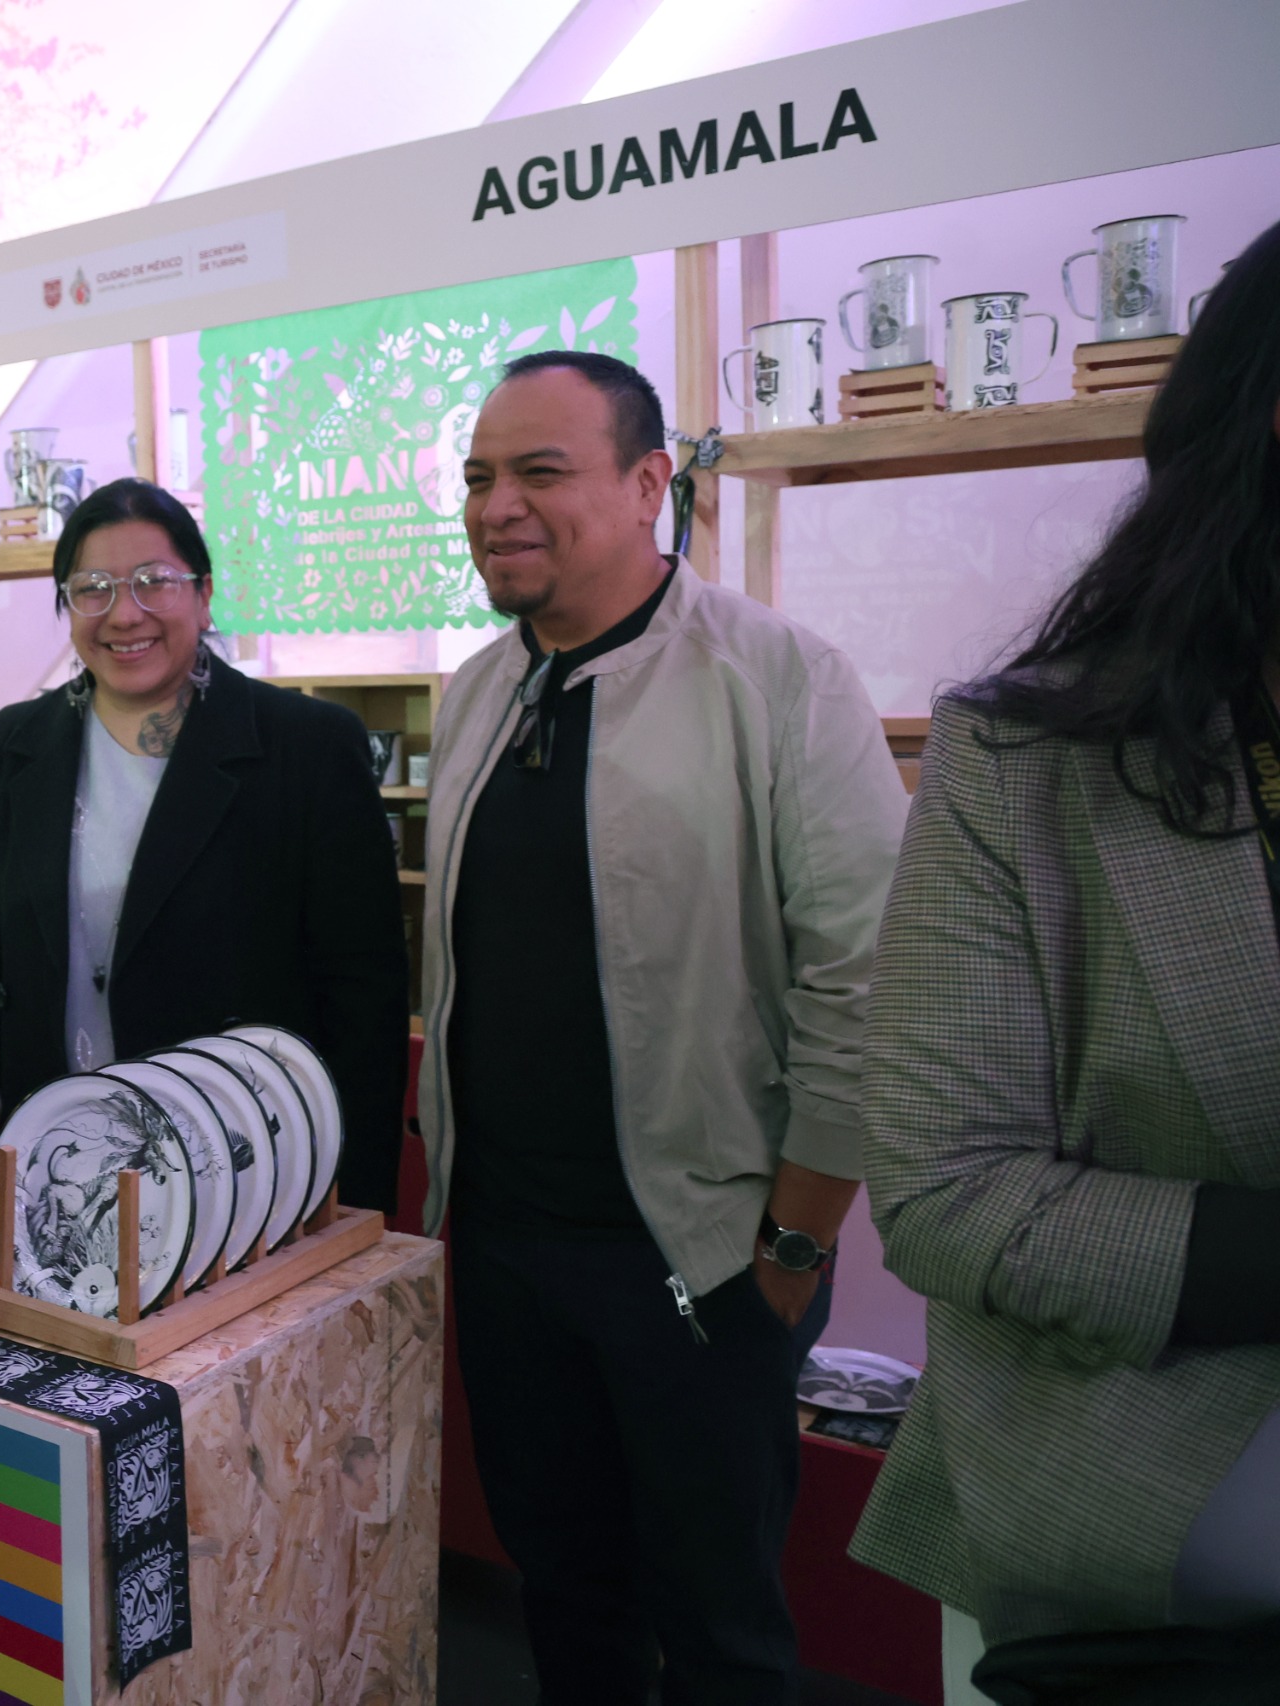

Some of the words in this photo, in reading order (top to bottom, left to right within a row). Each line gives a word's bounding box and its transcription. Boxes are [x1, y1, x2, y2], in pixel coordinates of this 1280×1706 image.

[472, 87, 878, 222] AGUAMALA
[96, 267, 131, 283] CIUDAD
[132, 264, 144, 276] DE
[297, 509, 319, 527] DE
[323, 508, 345, 524] LA
[350, 501, 418, 522] CIUDAD
[292, 526, 367, 546] Alebrijes
[371, 528, 382, 543] y
[322, 548, 338, 564] la
[344, 543, 411, 562] Ciudad
[417, 541, 441, 557] de
[24, 1383, 52, 1399] AGUA
[50, 1369, 85, 1385] MALA
[114, 1432, 141, 1454] AGUA
[141, 1416, 170, 1440] MALA
[141, 1540, 174, 1564] MALA
